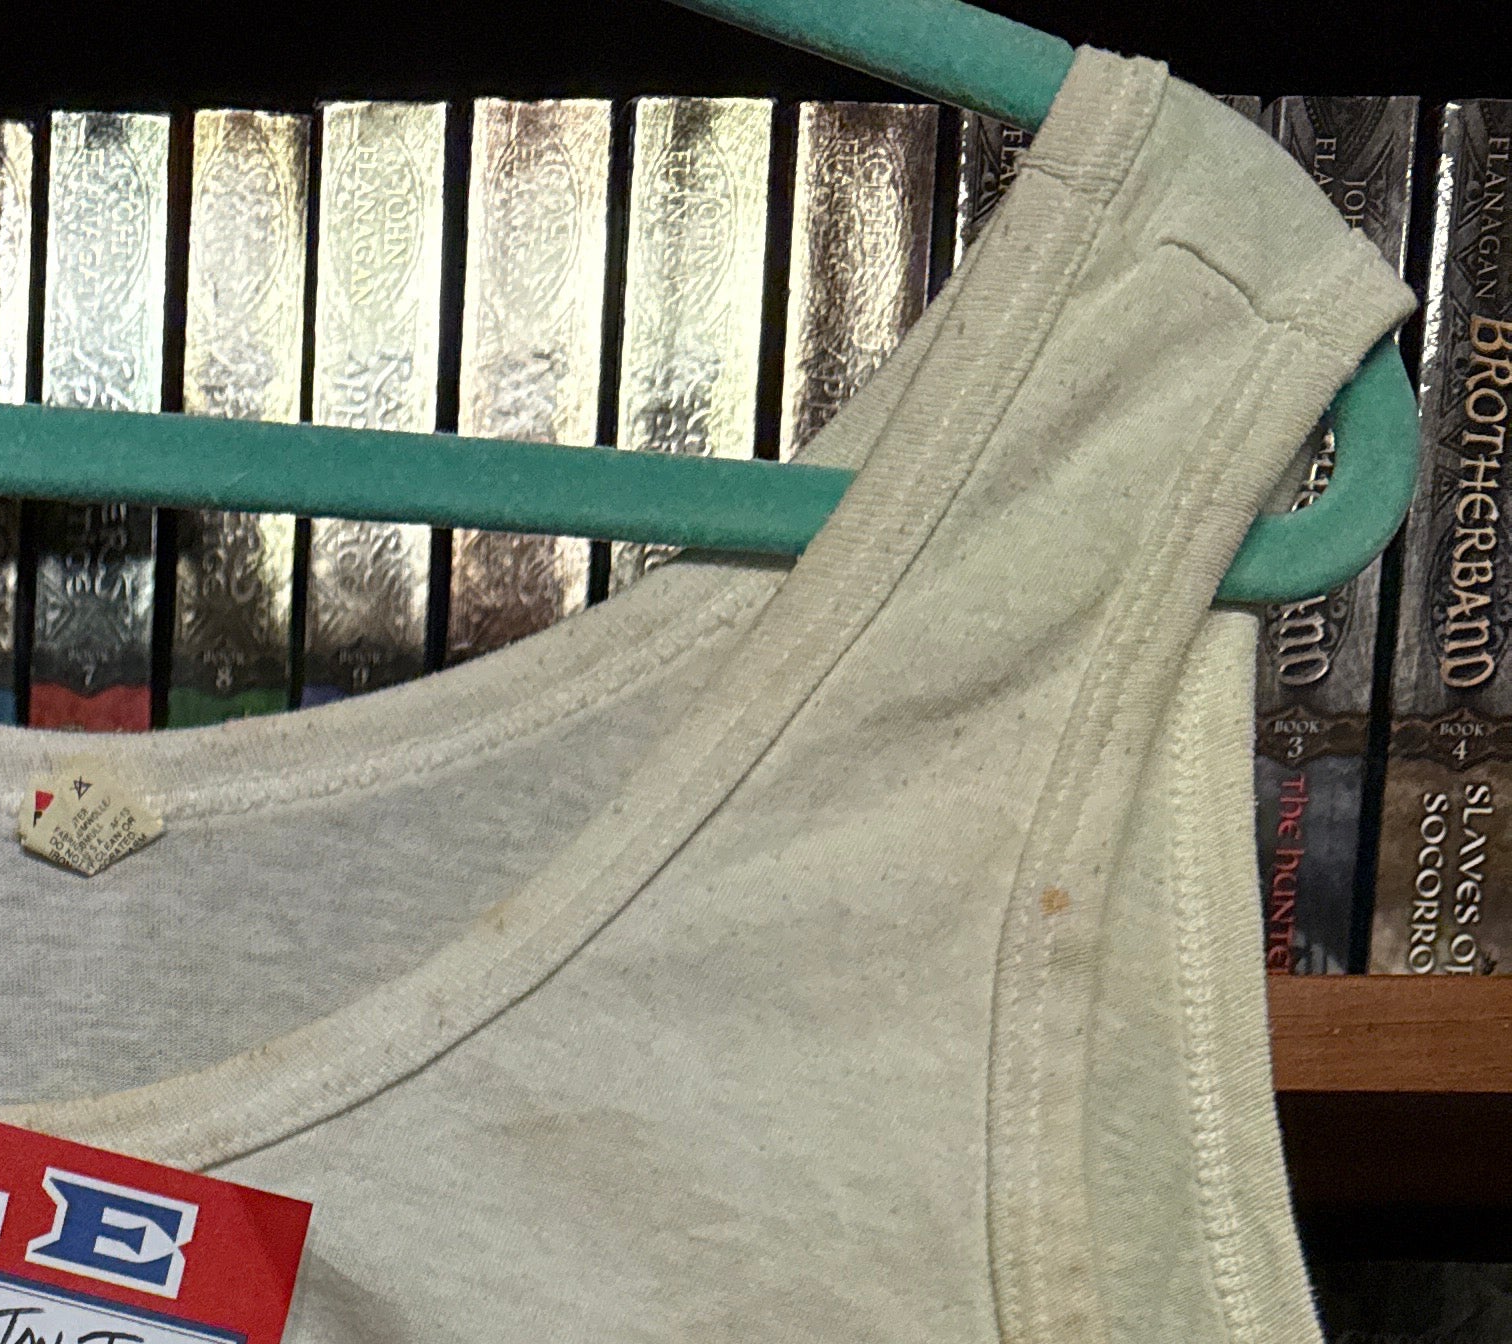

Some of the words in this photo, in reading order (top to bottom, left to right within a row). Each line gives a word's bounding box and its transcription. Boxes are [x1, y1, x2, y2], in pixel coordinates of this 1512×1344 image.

[1476, 137, 1509, 300] FLANAGAN
[1440, 314, 1512, 687] BROTHERBAND
[1274, 720, 1321, 733] BOOK
[1288, 737, 1304, 757] 3
[1439, 723, 1485, 736] BOOK
[1452, 740, 1468, 760] 4
[1409, 792, 1448, 974] SOCORRO
[1454, 784, 1493, 925] SLAVES
